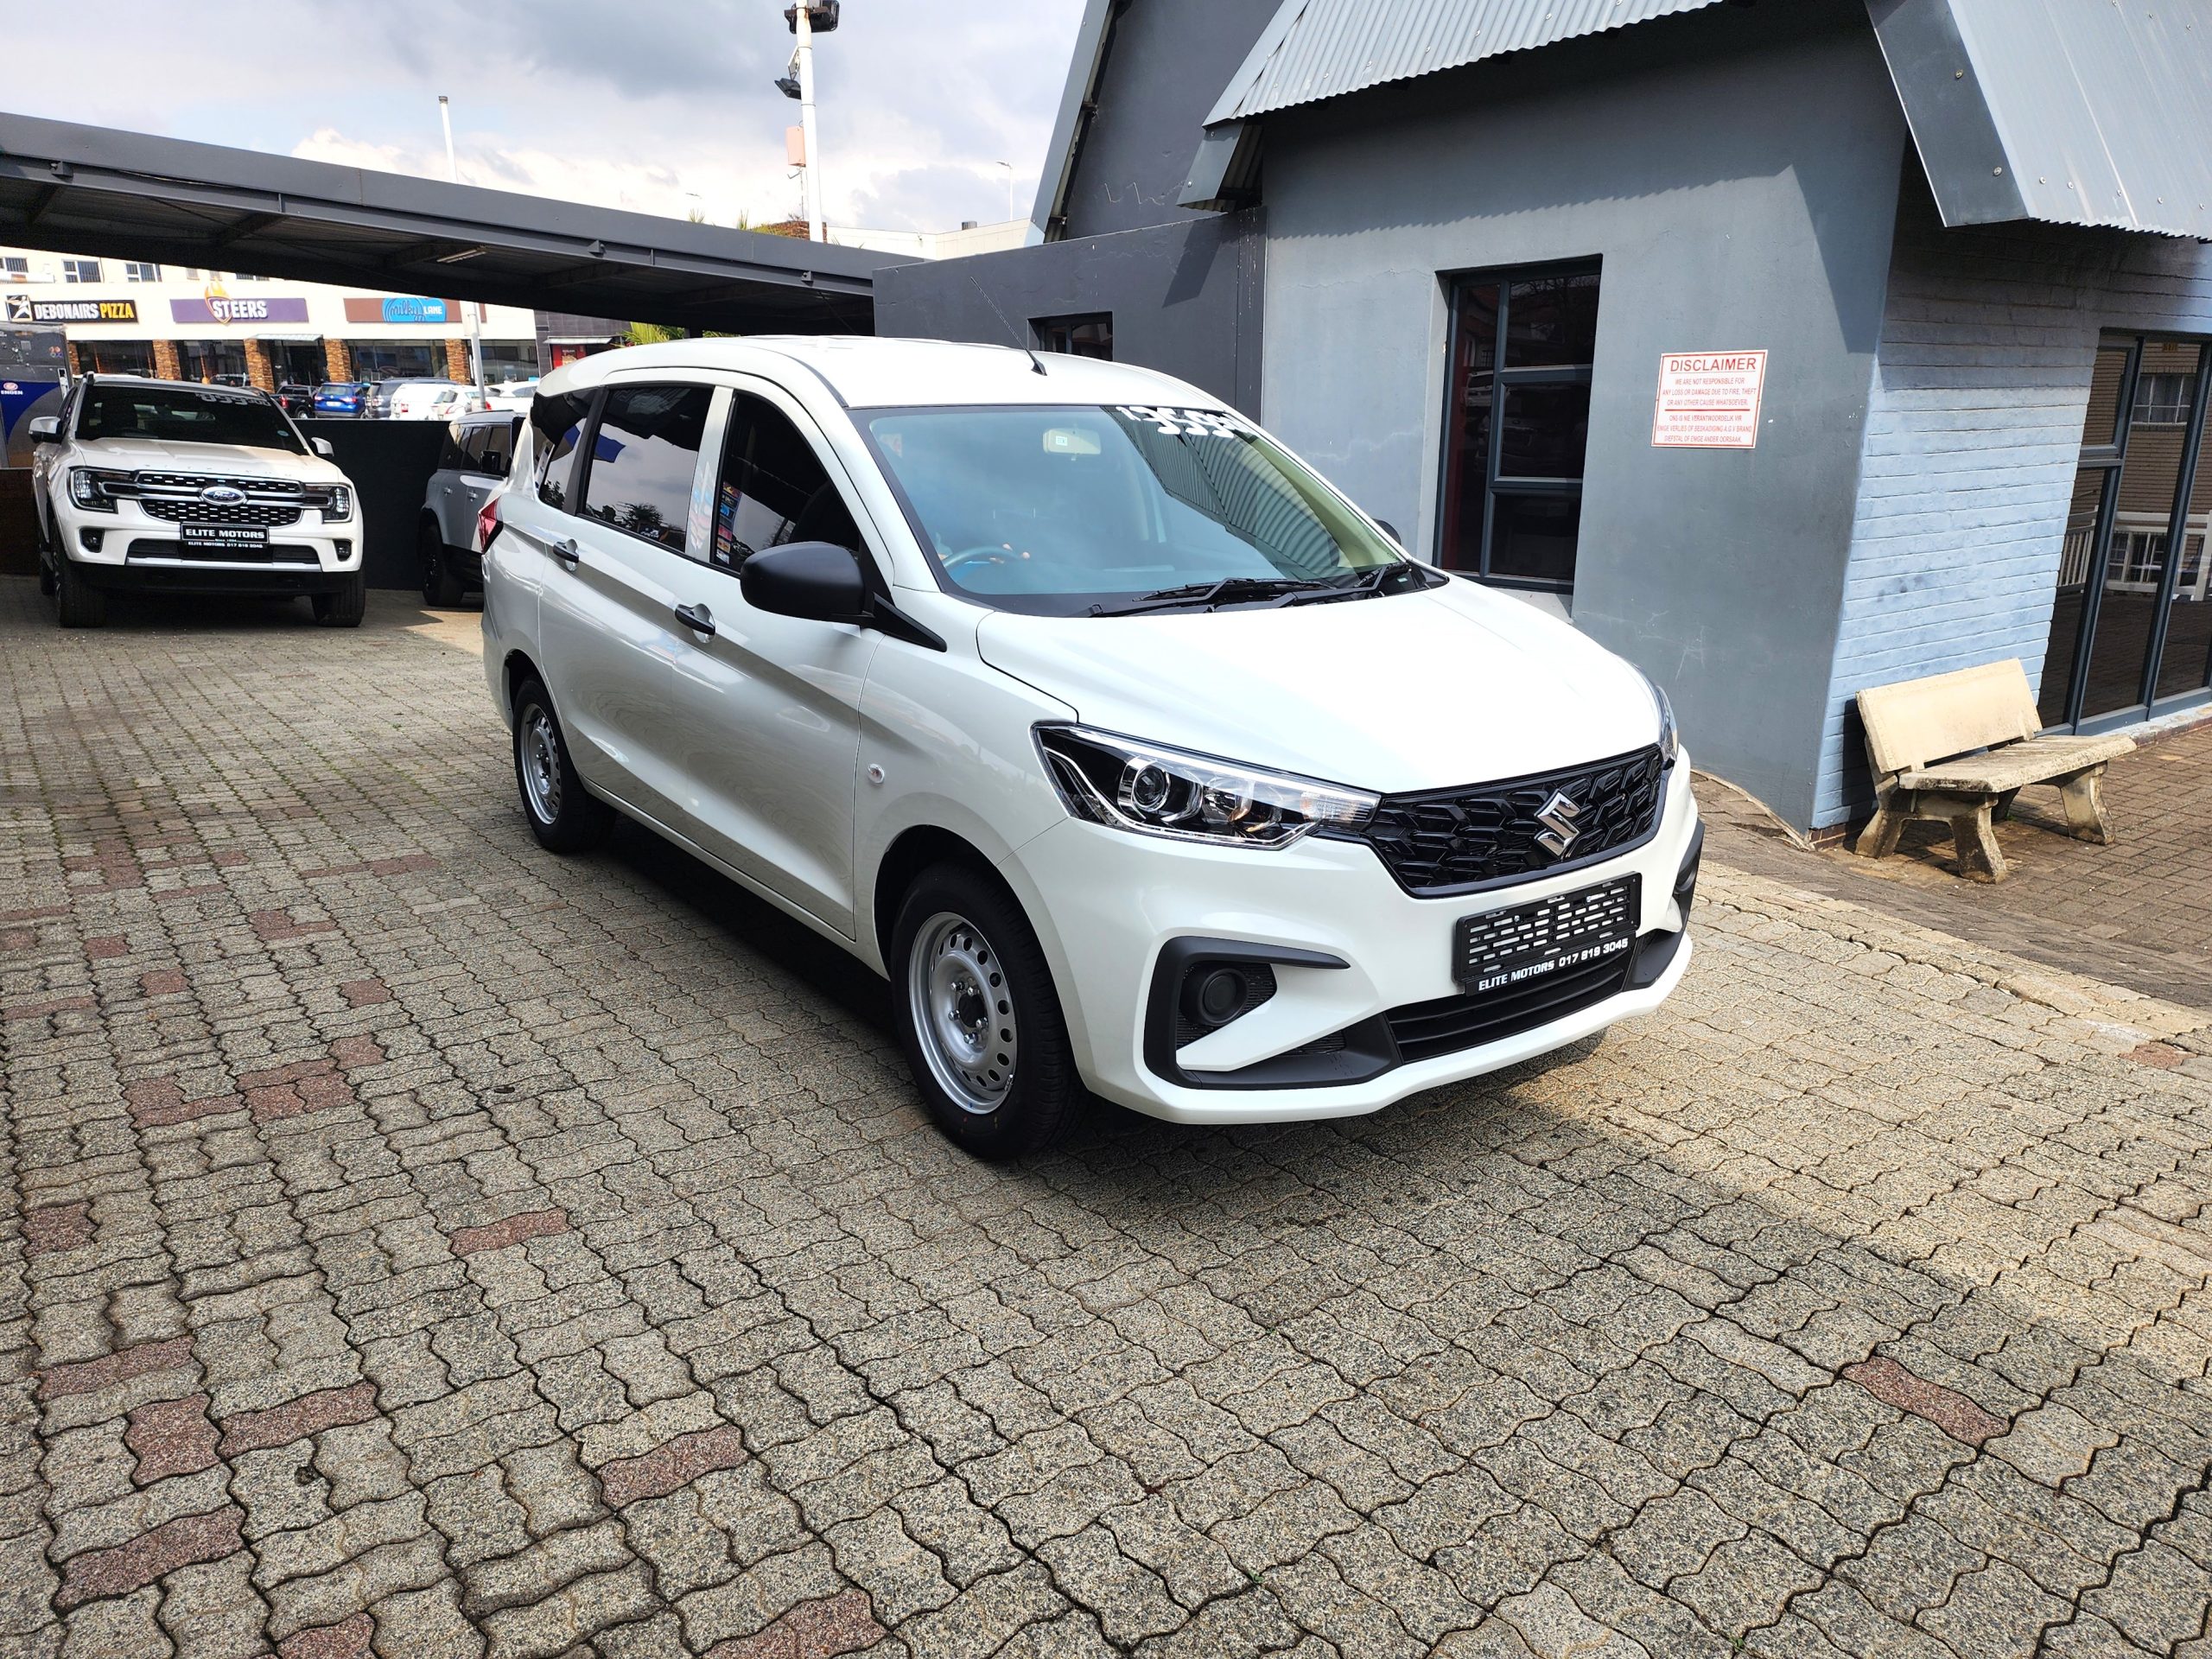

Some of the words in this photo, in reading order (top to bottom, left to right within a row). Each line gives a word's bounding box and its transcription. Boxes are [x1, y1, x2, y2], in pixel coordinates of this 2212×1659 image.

[34, 303, 99, 320] DEBONAIRS
[99, 302, 135, 319] PIZZA
[212, 300, 268, 319] STEERS
[423, 305, 443, 315] LANE
[1670, 358, 1757, 372] DISCLAIMER
[186, 528, 216, 537] ELITE
[219, 530, 265, 539] MOTORS
[1478, 975, 1509, 991] ELITE
[1510, 960, 1555, 982] MOTORS
[1559, 954, 1579, 968] 017
[1580, 946, 1601, 961] 819
[1603, 938, 1629, 954] 3045
